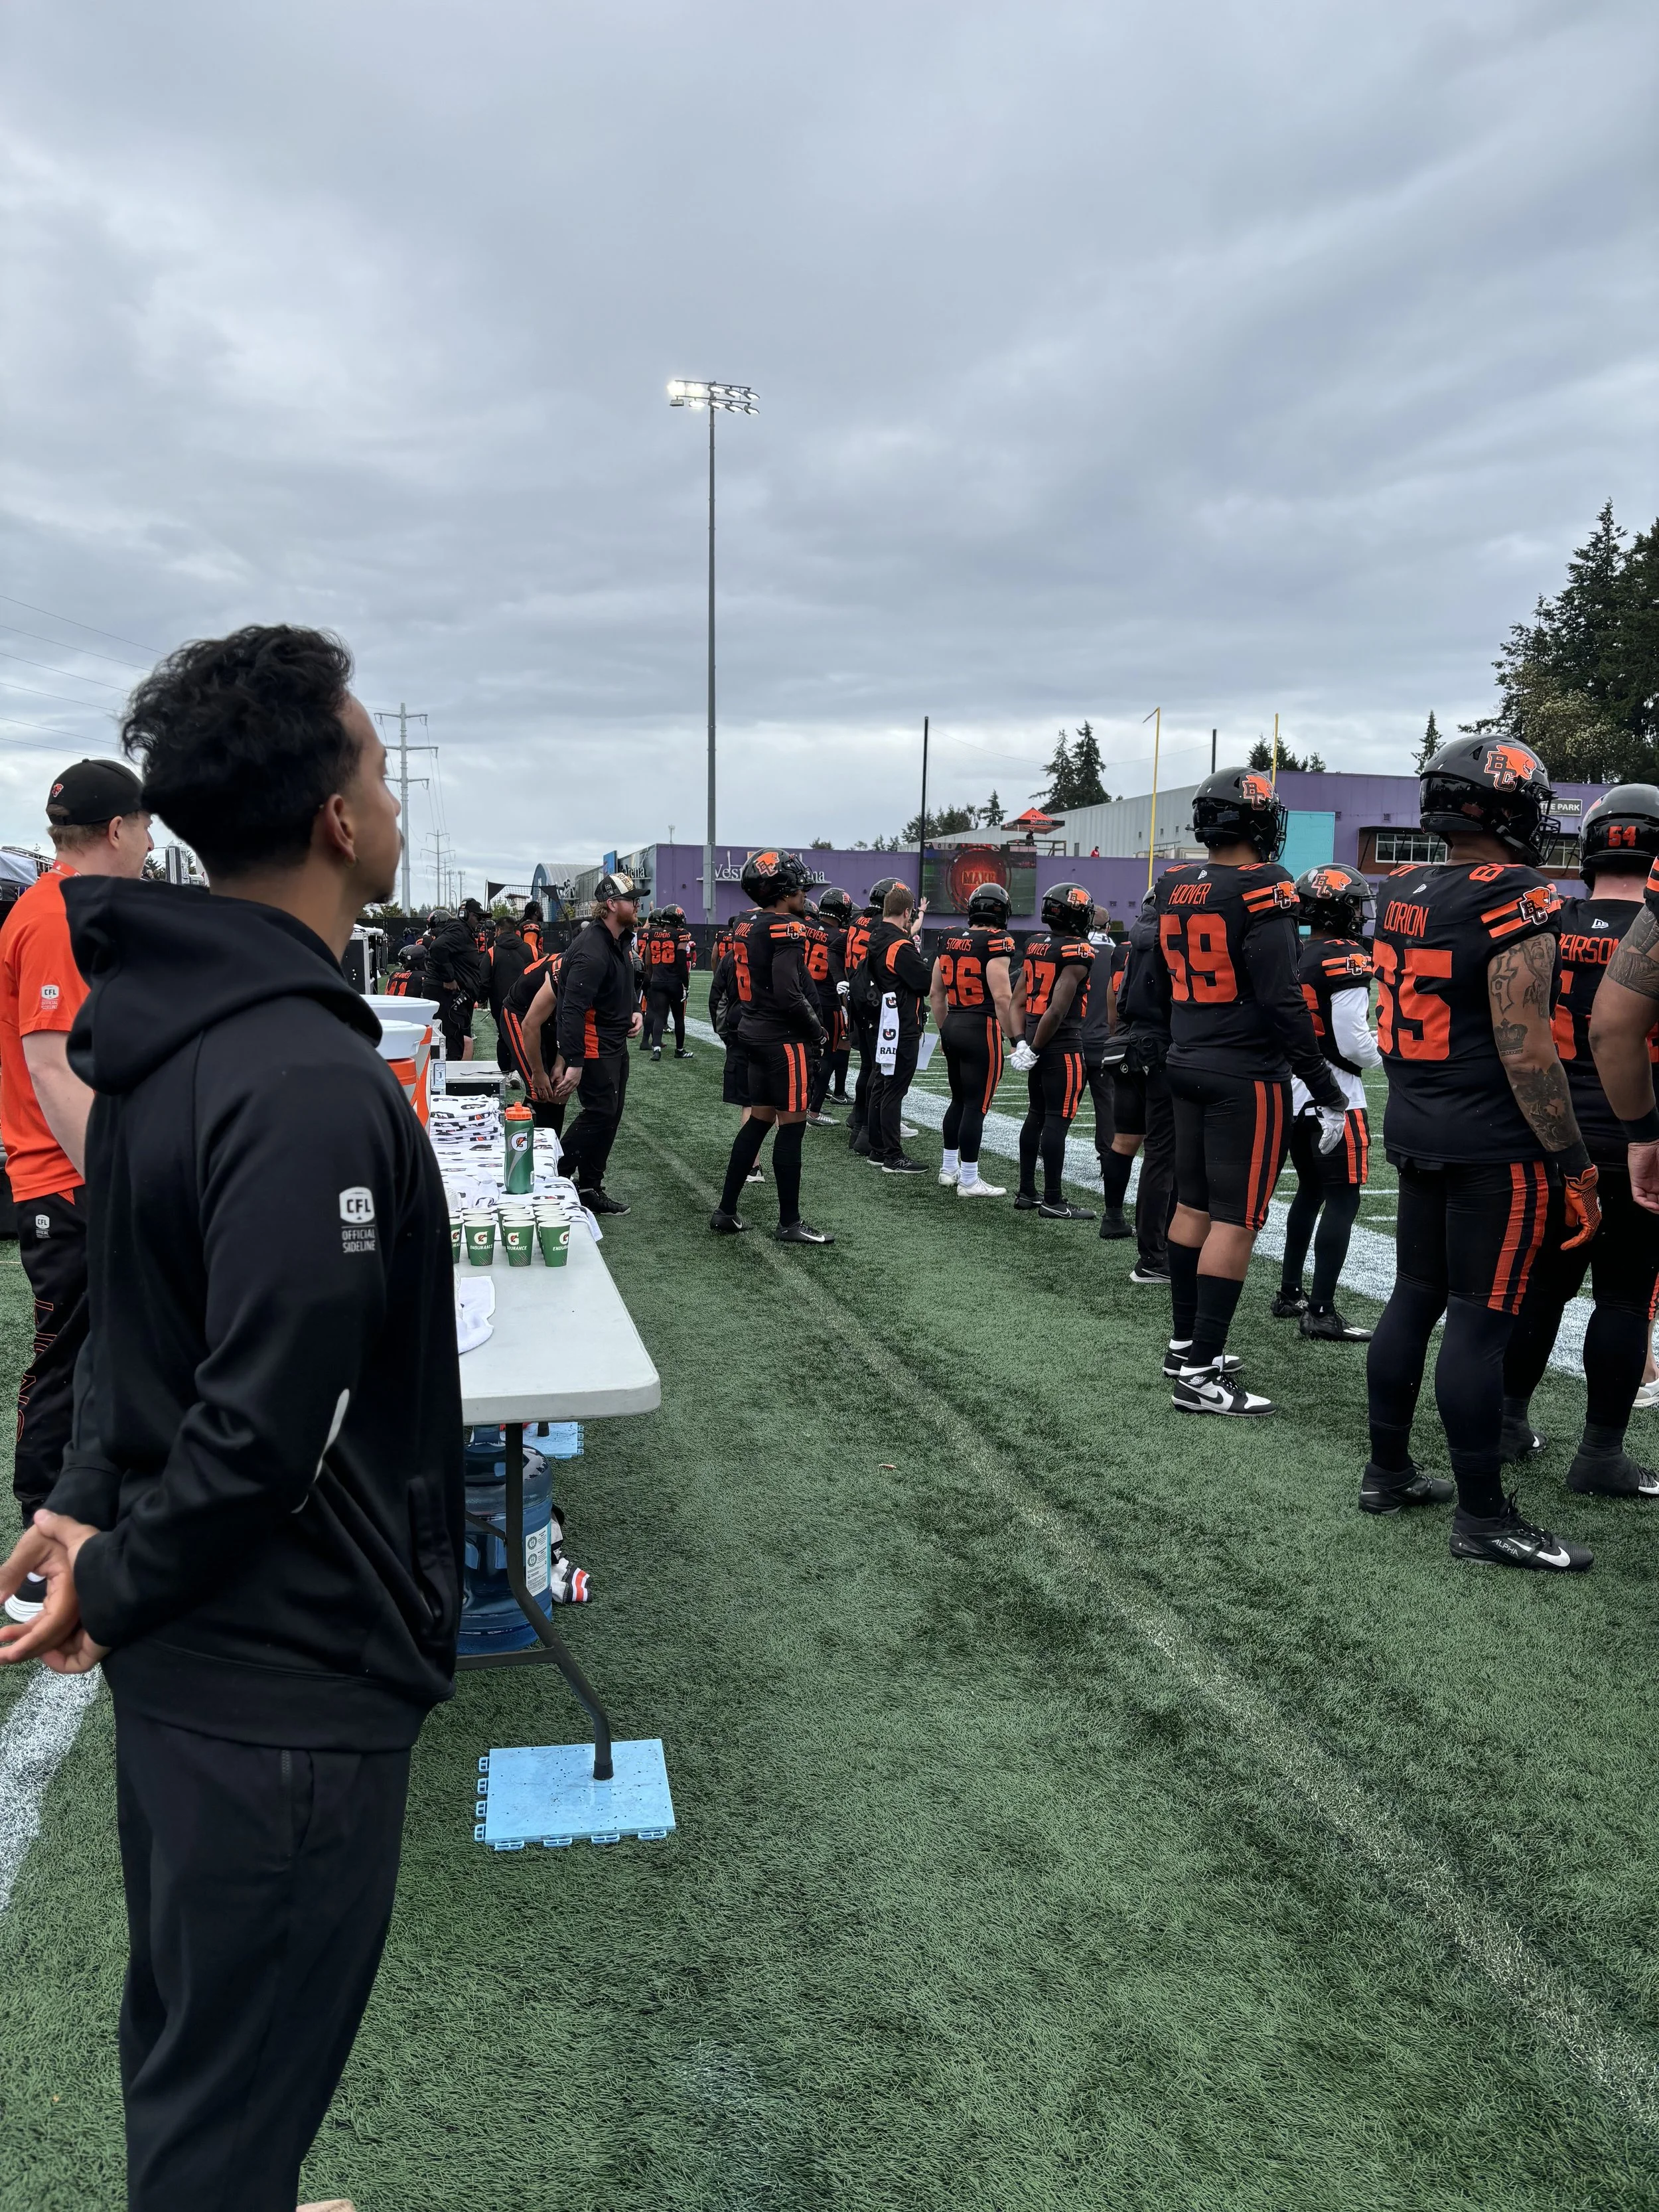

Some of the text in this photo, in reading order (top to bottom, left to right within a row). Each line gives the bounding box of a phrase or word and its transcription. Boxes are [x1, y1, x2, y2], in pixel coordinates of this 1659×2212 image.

[1608, 826, 1636, 847] 54
[1168, 883, 1212, 905] HOOVER
[1384, 900, 1430, 937] DORION
[939, 954, 985, 1007] 26
[510, 1132, 528, 1152] G
[346, 1198, 372, 1213] CFL
[341, 1228, 376, 1241] OFFICIAL
[342, 1240, 376, 1254] SIDELINE
[1491, 1539, 1519, 1557] ALPHA
